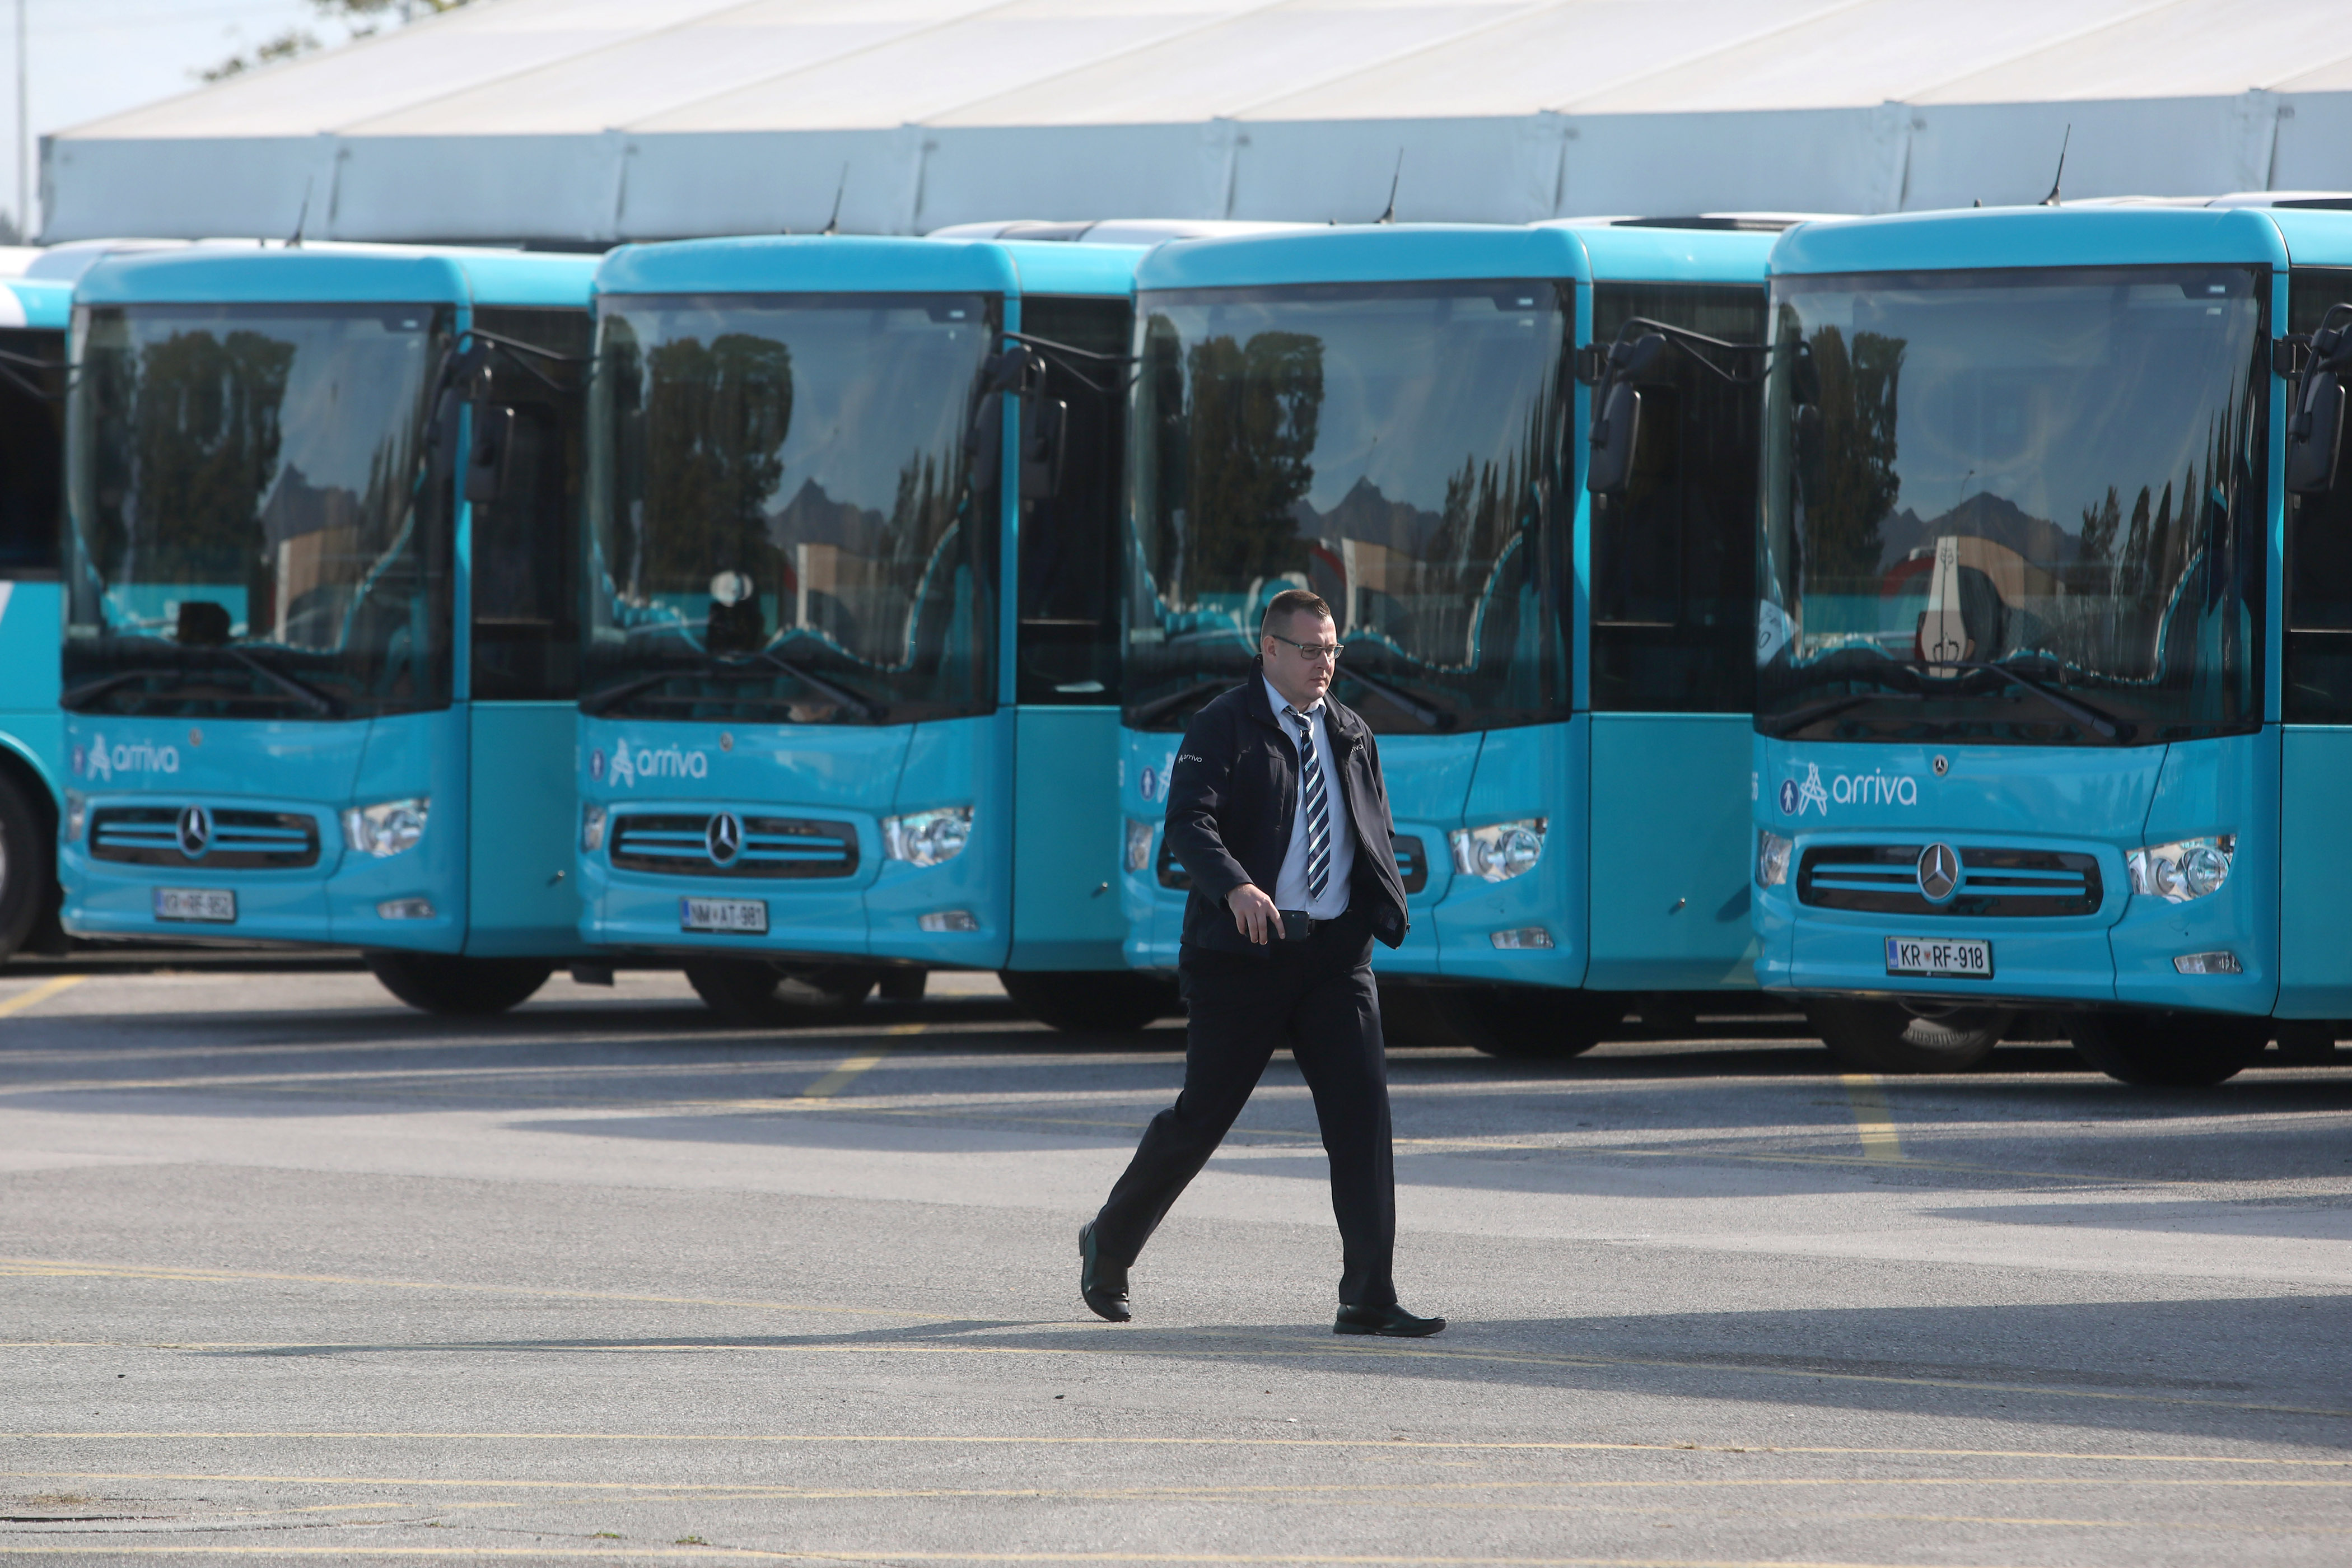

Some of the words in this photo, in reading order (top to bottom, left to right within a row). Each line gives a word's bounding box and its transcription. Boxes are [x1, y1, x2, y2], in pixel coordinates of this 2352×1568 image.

[113, 738, 179, 773] arriva
[636, 742, 707, 778] arriva
[1183, 754, 1202, 762] arriva
[1833, 767, 1917, 806] arriva
[691, 905, 711, 922] NM
[1901, 944, 1921, 967] KR
[1933, 945, 1984, 969] RF-918
